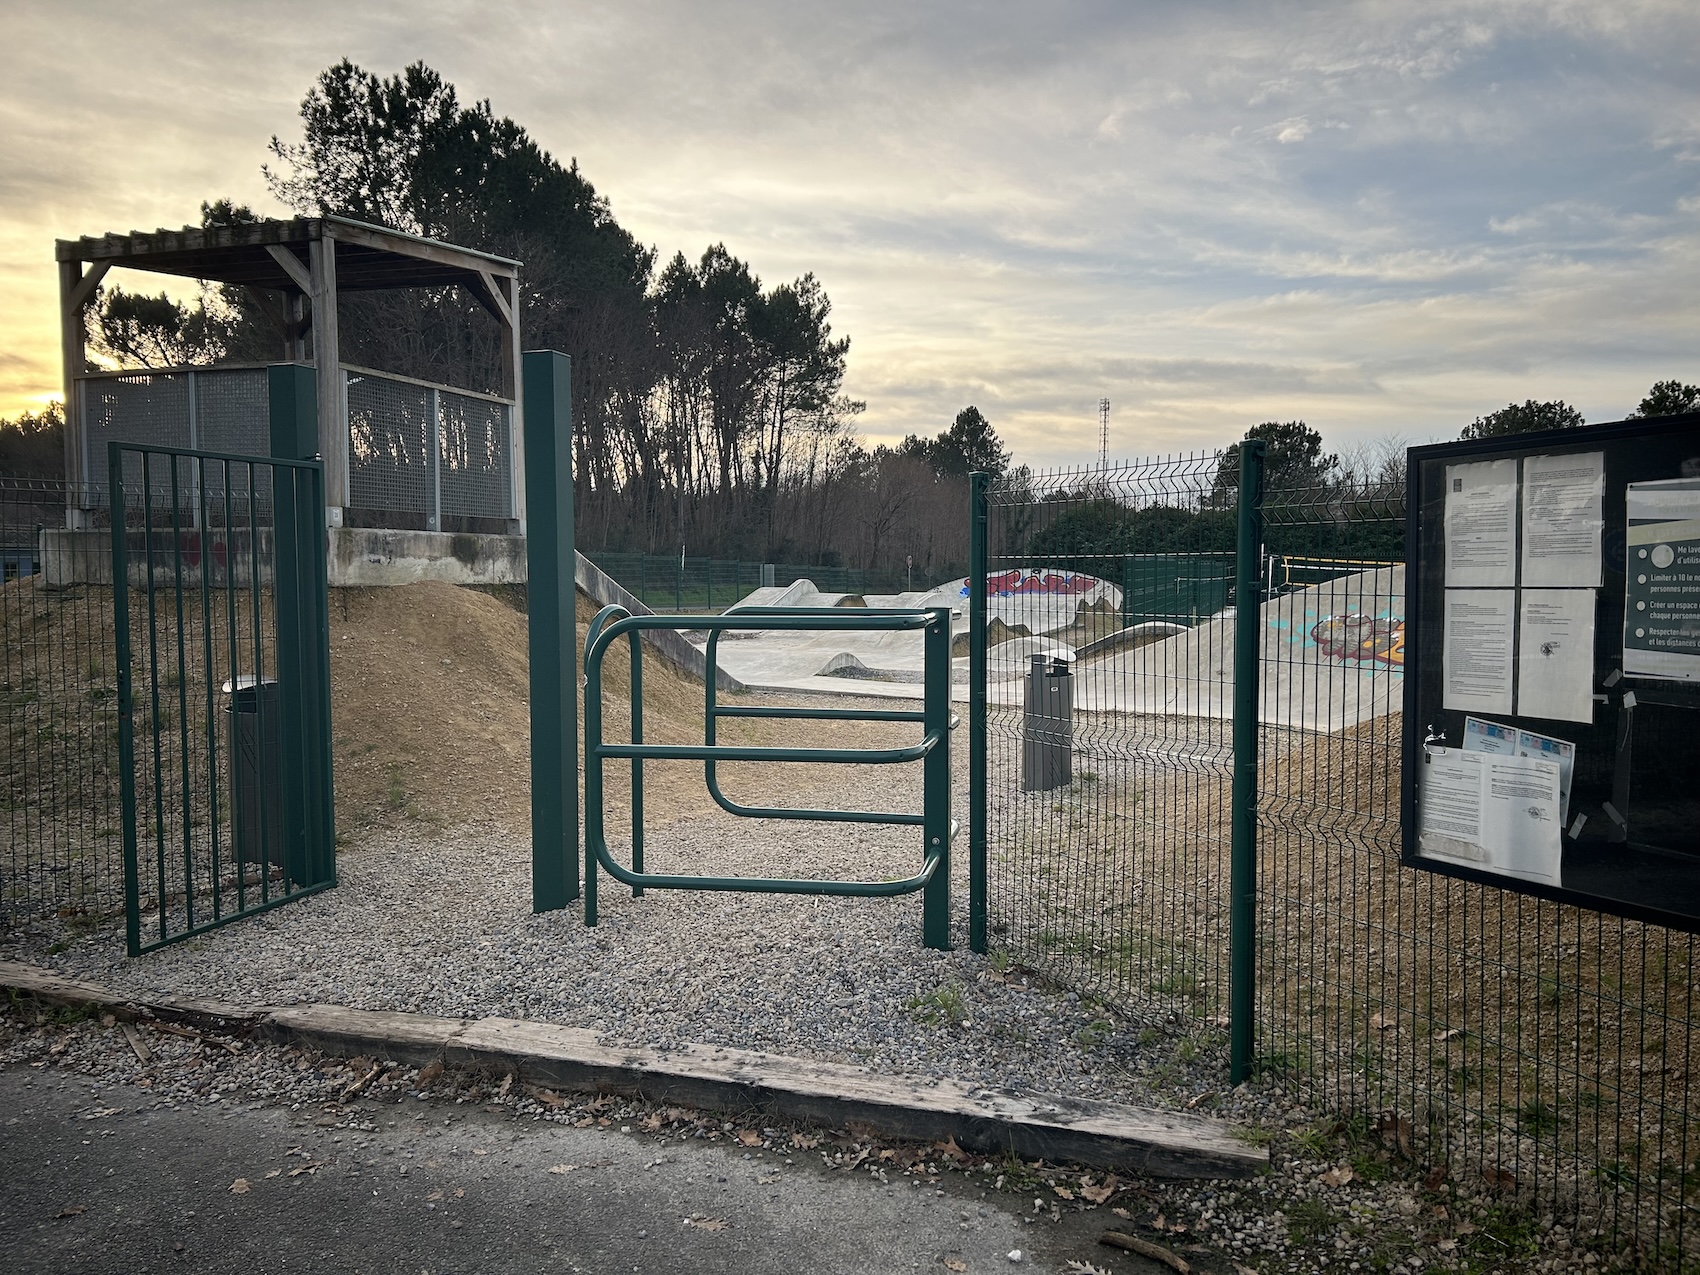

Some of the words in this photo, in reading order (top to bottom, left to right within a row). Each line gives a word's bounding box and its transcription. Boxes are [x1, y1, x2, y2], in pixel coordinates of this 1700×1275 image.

[1650, 586, 1681, 594] personnes
[1682, 585, 1700, 594] prése
[1650, 600, 1666, 609] Créer
[1676, 602, 1698, 610] espace
[1650, 612, 1671, 620] chaque
[1649, 628, 1679, 636] Respecter
[1666, 639, 1696, 647] distances
